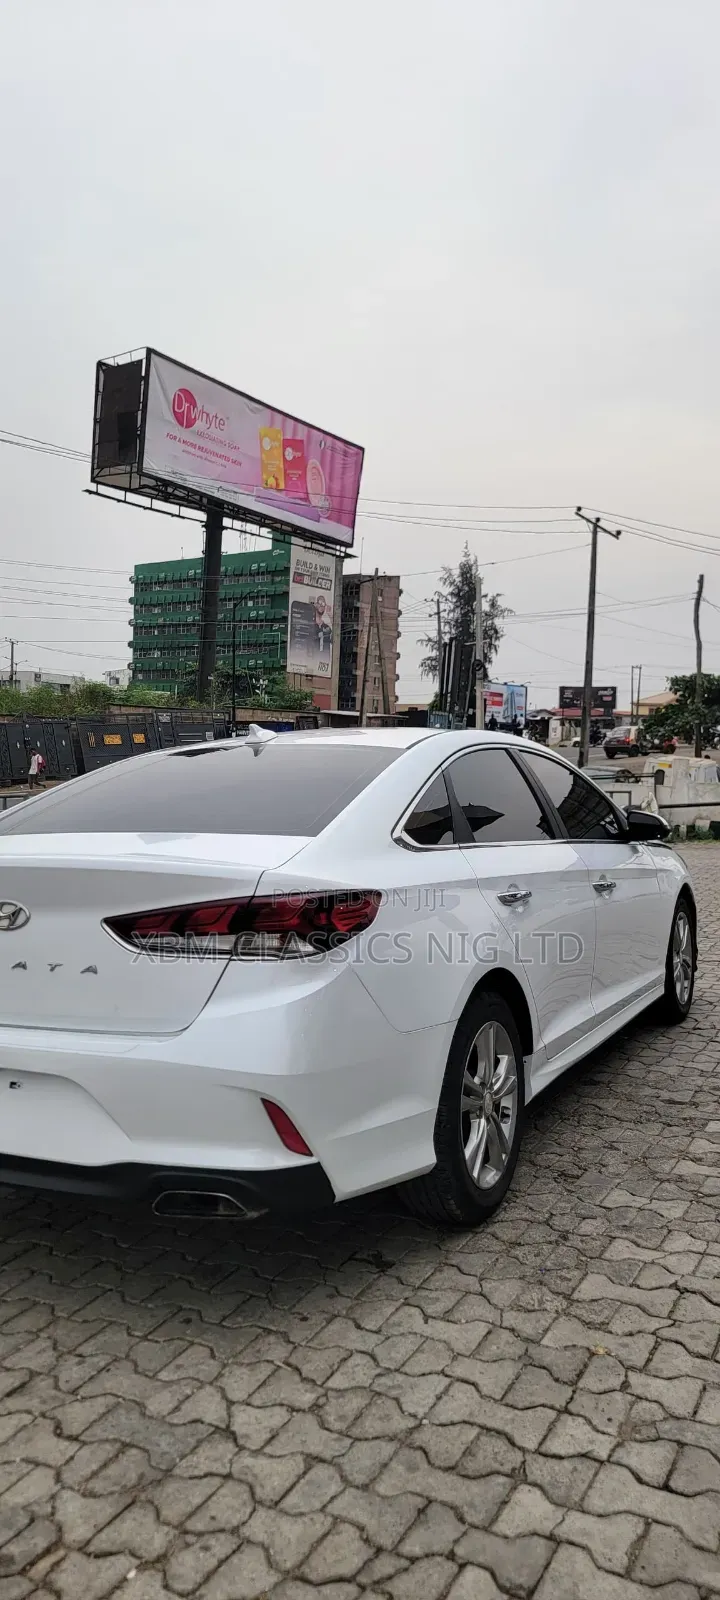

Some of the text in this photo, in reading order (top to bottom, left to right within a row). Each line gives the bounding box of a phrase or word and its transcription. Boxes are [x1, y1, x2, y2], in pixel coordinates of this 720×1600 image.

[166, 432, 178, 442] FOR
[182, 439, 198, 450] MORE
[197, 445, 231, 463] REJUVENATED
[230, 458, 243, 468] SKIN
[295, 559, 313, 569] BUILD
[318, 565, 331, 574] WIN
